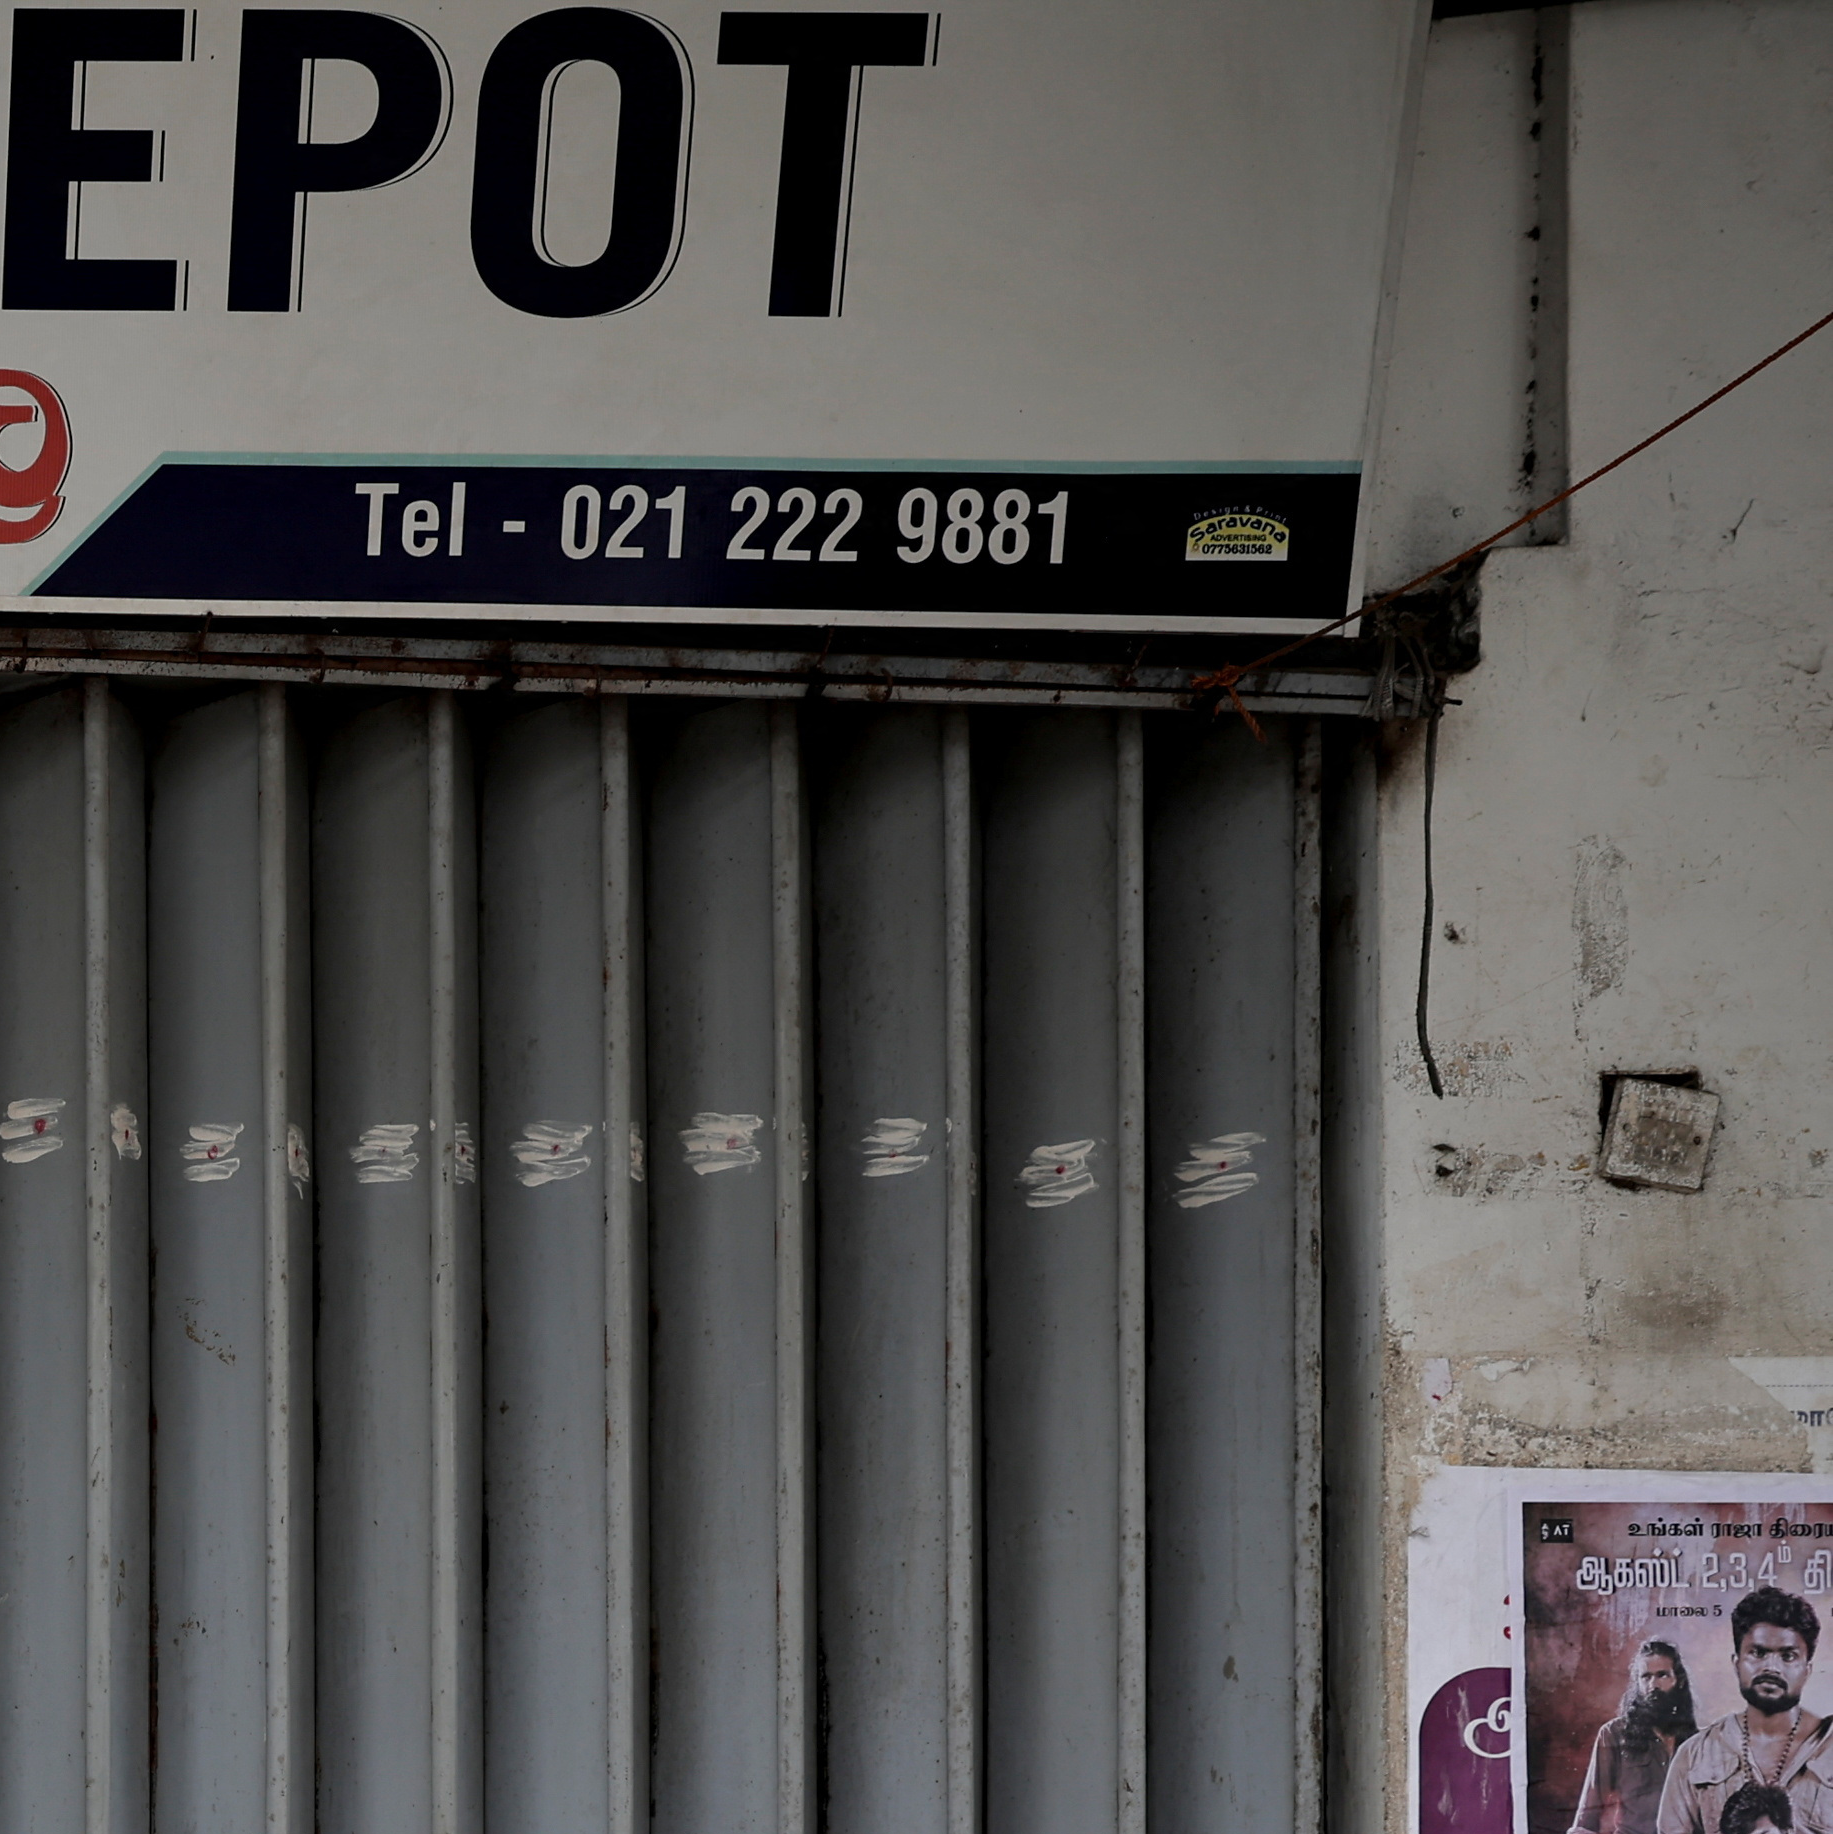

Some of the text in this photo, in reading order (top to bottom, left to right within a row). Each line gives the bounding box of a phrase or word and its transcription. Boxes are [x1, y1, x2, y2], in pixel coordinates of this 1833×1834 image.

[354, 482, 1071, 567] Tel - 021 222 9881
[1189, 516, 1287, 544] Saravana
[1201, 543, 1273, 555] 0775631562
[1209, 534, 1268, 542] ADVERTISING
[1627, 1516, 1704, 1538] உங்கள்
[1709, 1521, 1762, 1539] ராஜா
[1576, 1547, 1690, 1596] ஆகஸ்ட்
[1656, 1605, 1722, 1618] மாலை 5
